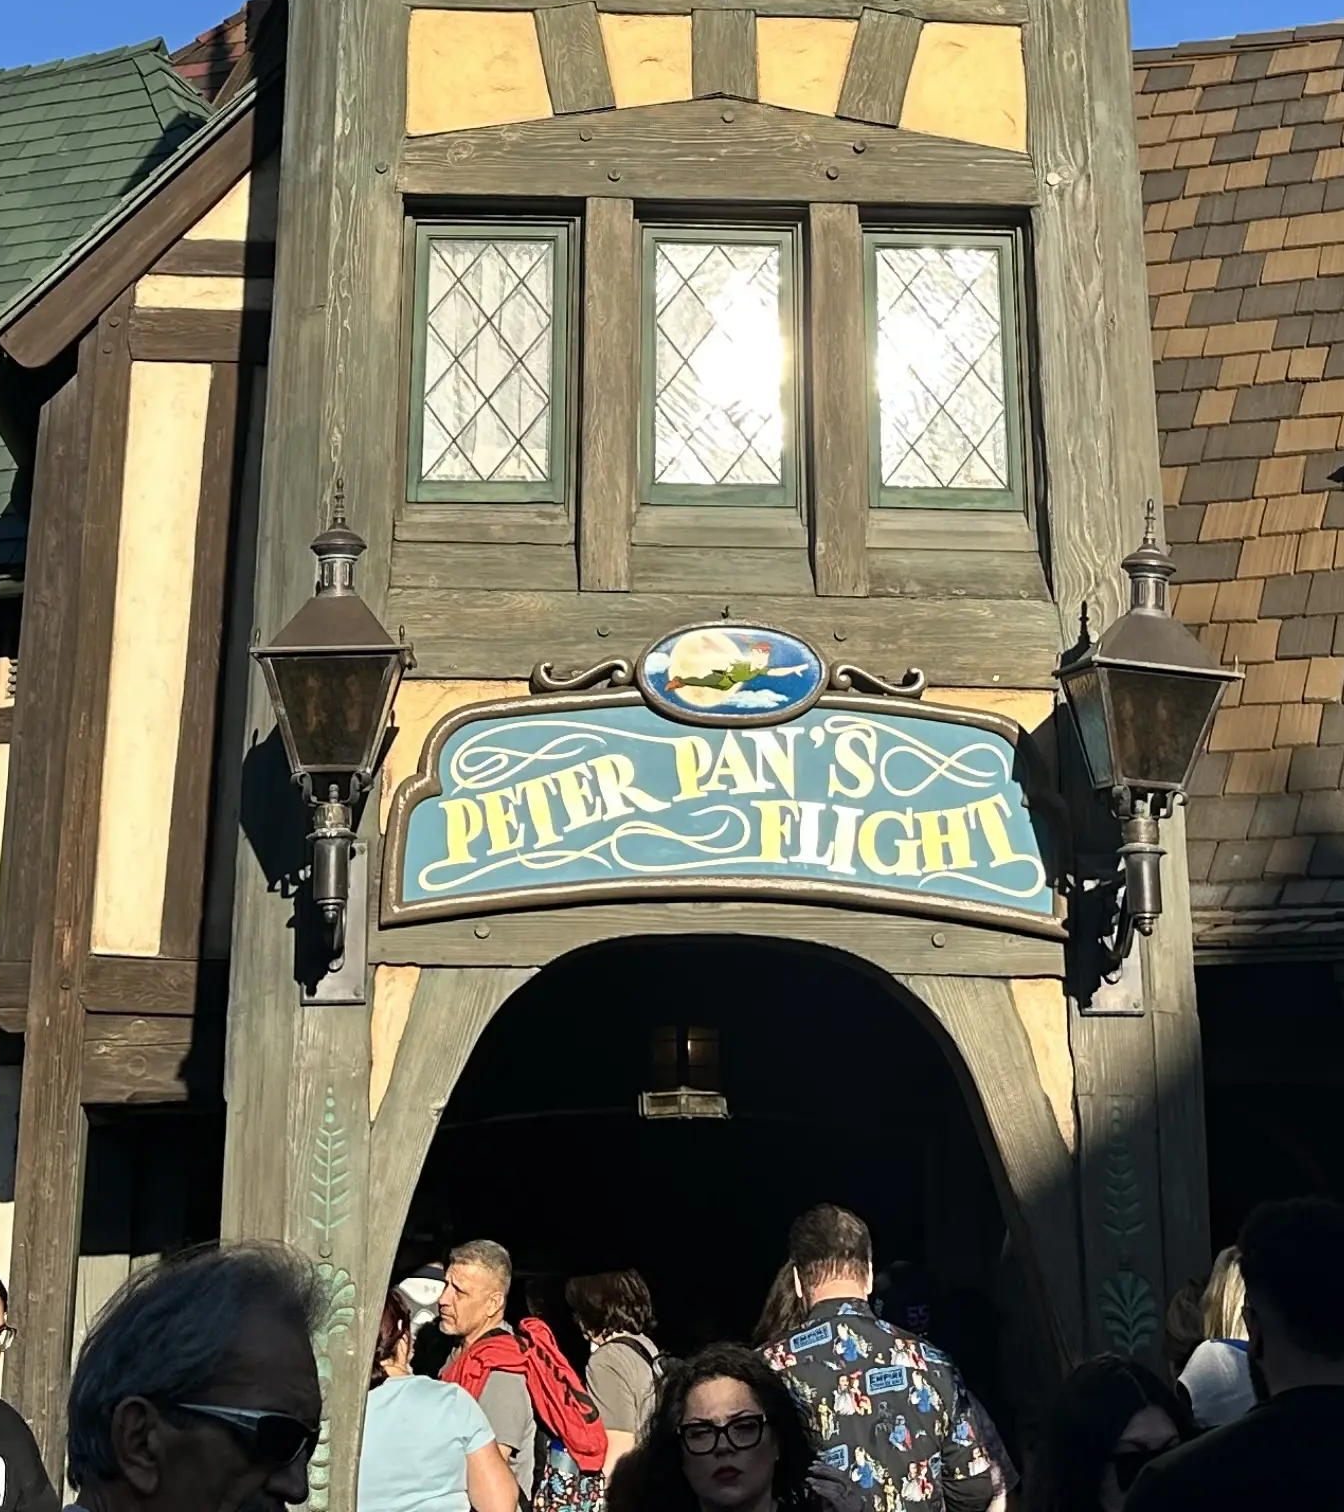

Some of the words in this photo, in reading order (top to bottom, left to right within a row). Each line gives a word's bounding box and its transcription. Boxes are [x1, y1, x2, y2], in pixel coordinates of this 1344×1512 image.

[438, 752, 668, 865] PETER
[672, 717, 877, 800] PAN'S
[751, 799, 1020, 876] FLIGHT
